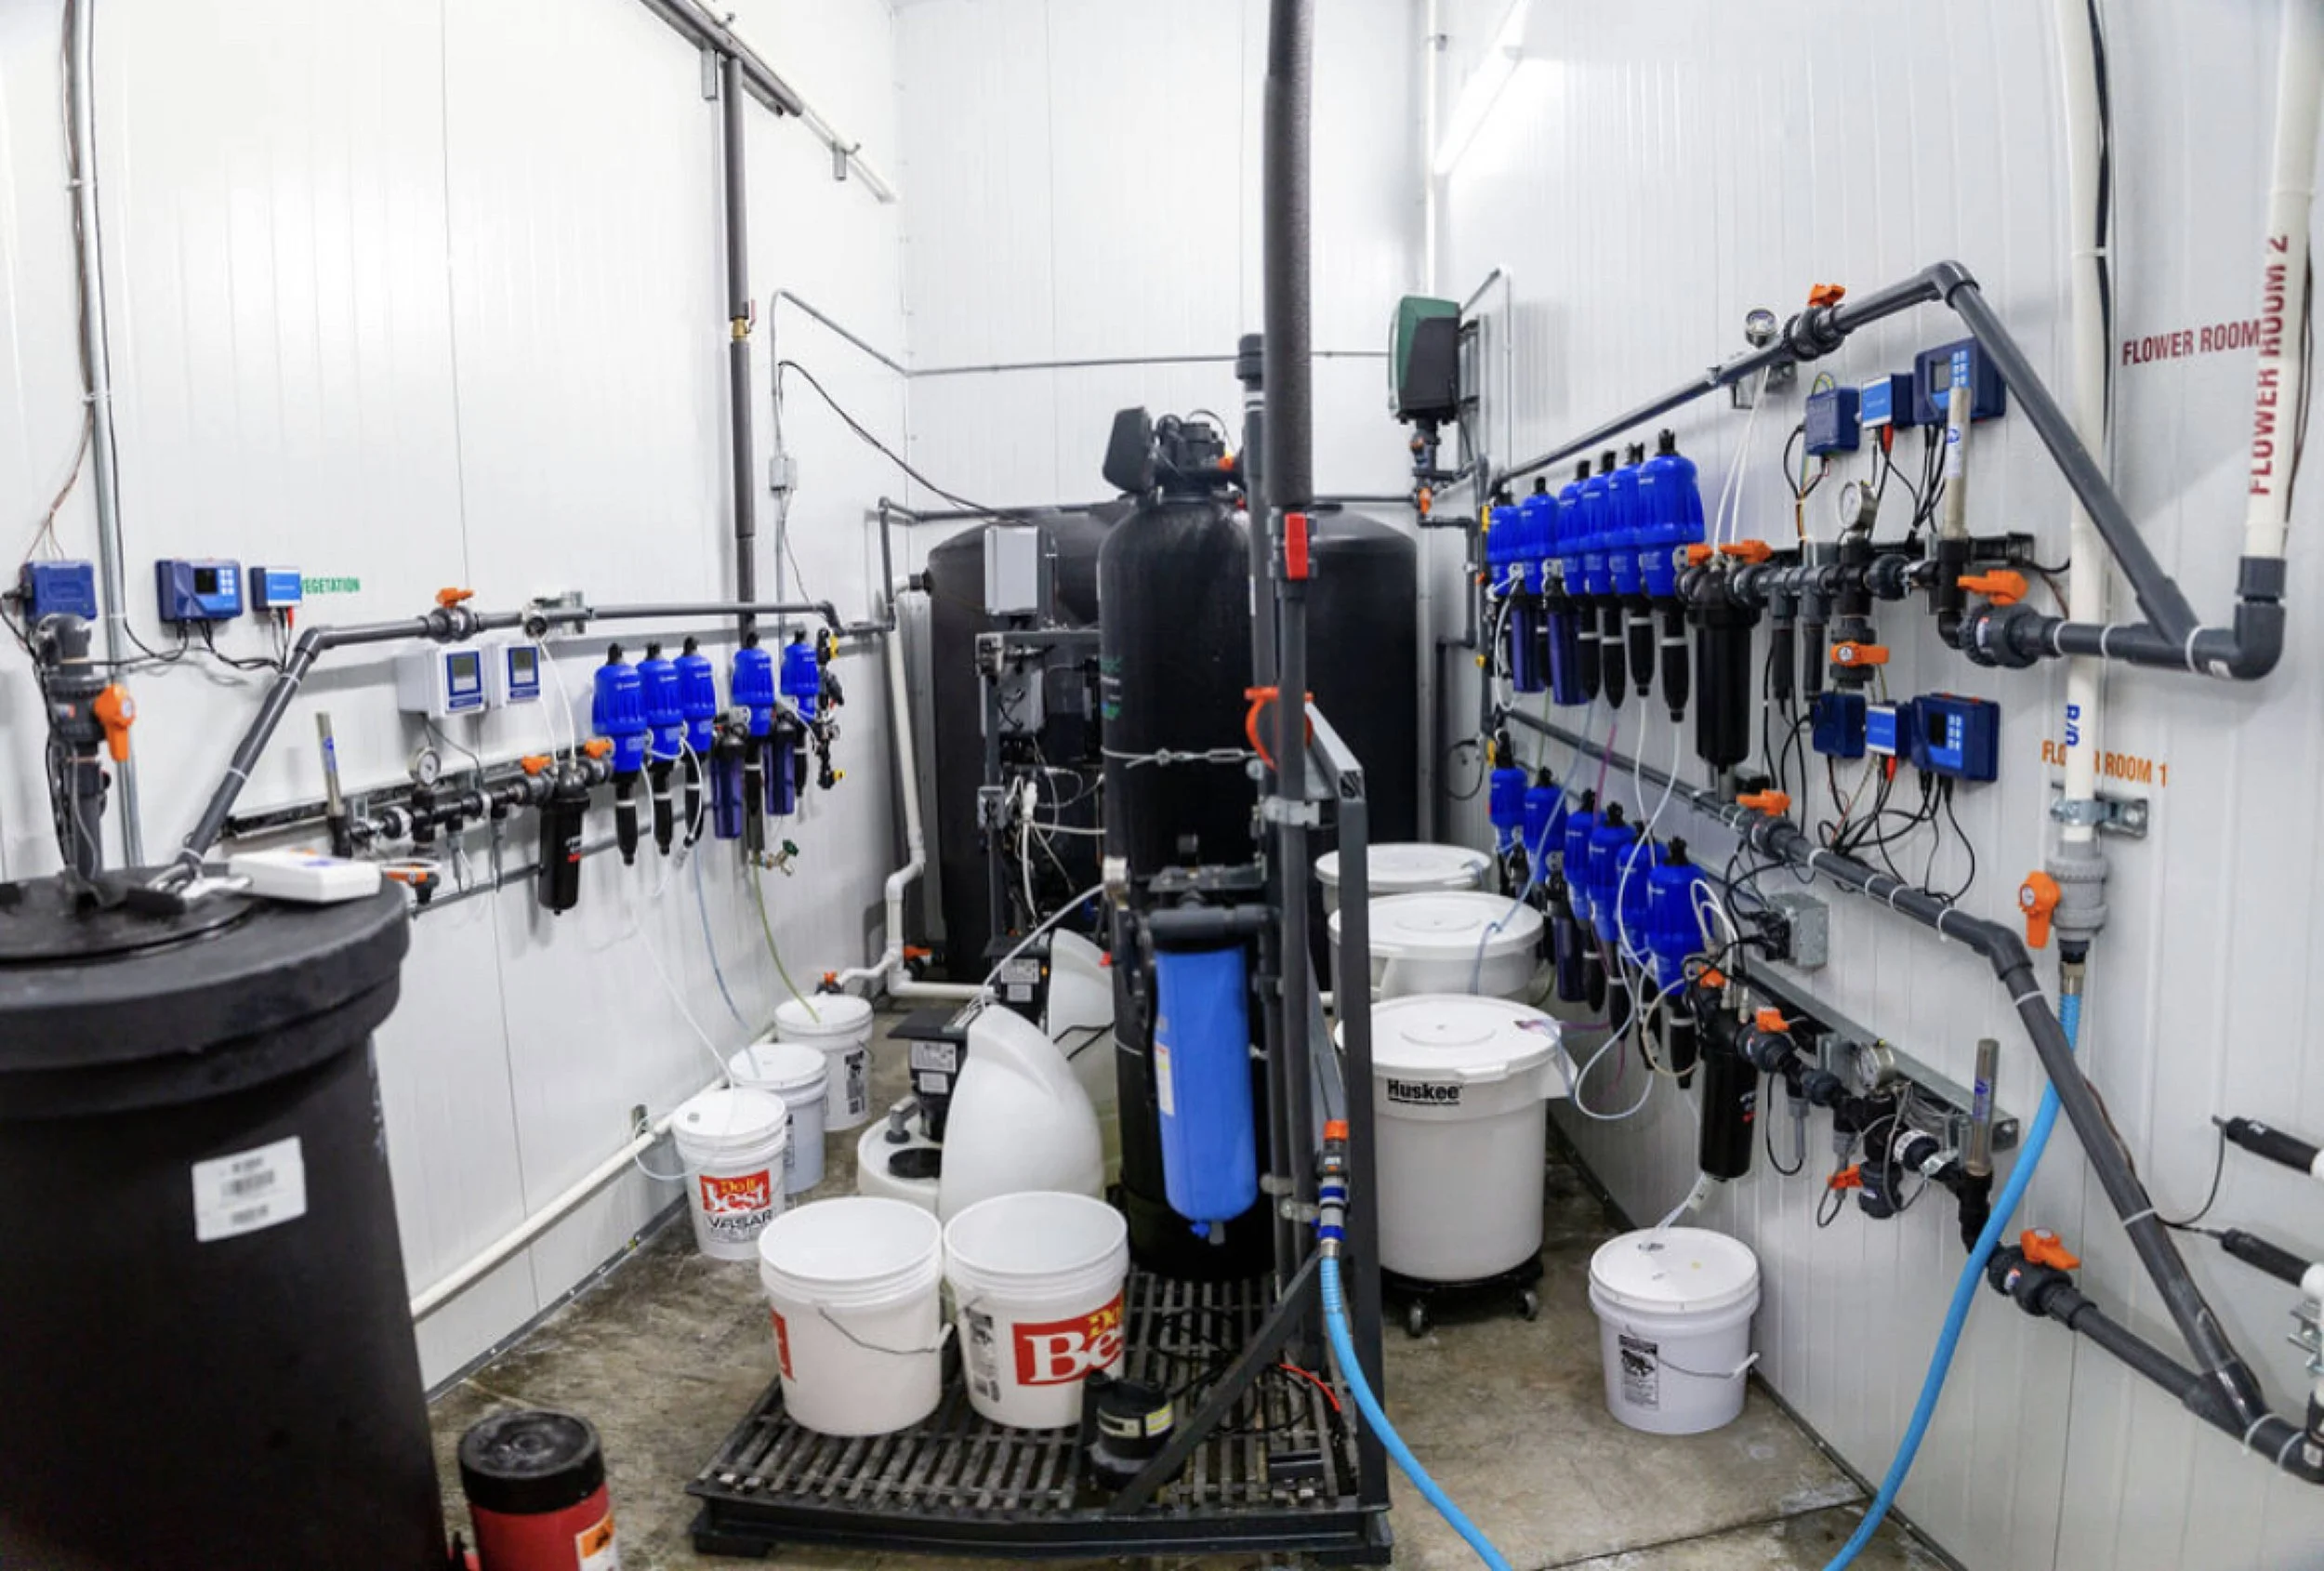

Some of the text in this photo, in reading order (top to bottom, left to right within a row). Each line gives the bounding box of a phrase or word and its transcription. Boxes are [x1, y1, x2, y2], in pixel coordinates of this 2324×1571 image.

[2269, 234, 2289, 254] 2
[2122, 319, 2261, 366] FLOWER ROOM
[2105, 751, 2153, 784] ROOM
[2158, 762, 2169, 788] 1
[1388, 1078, 1459, 1101] Huskee
